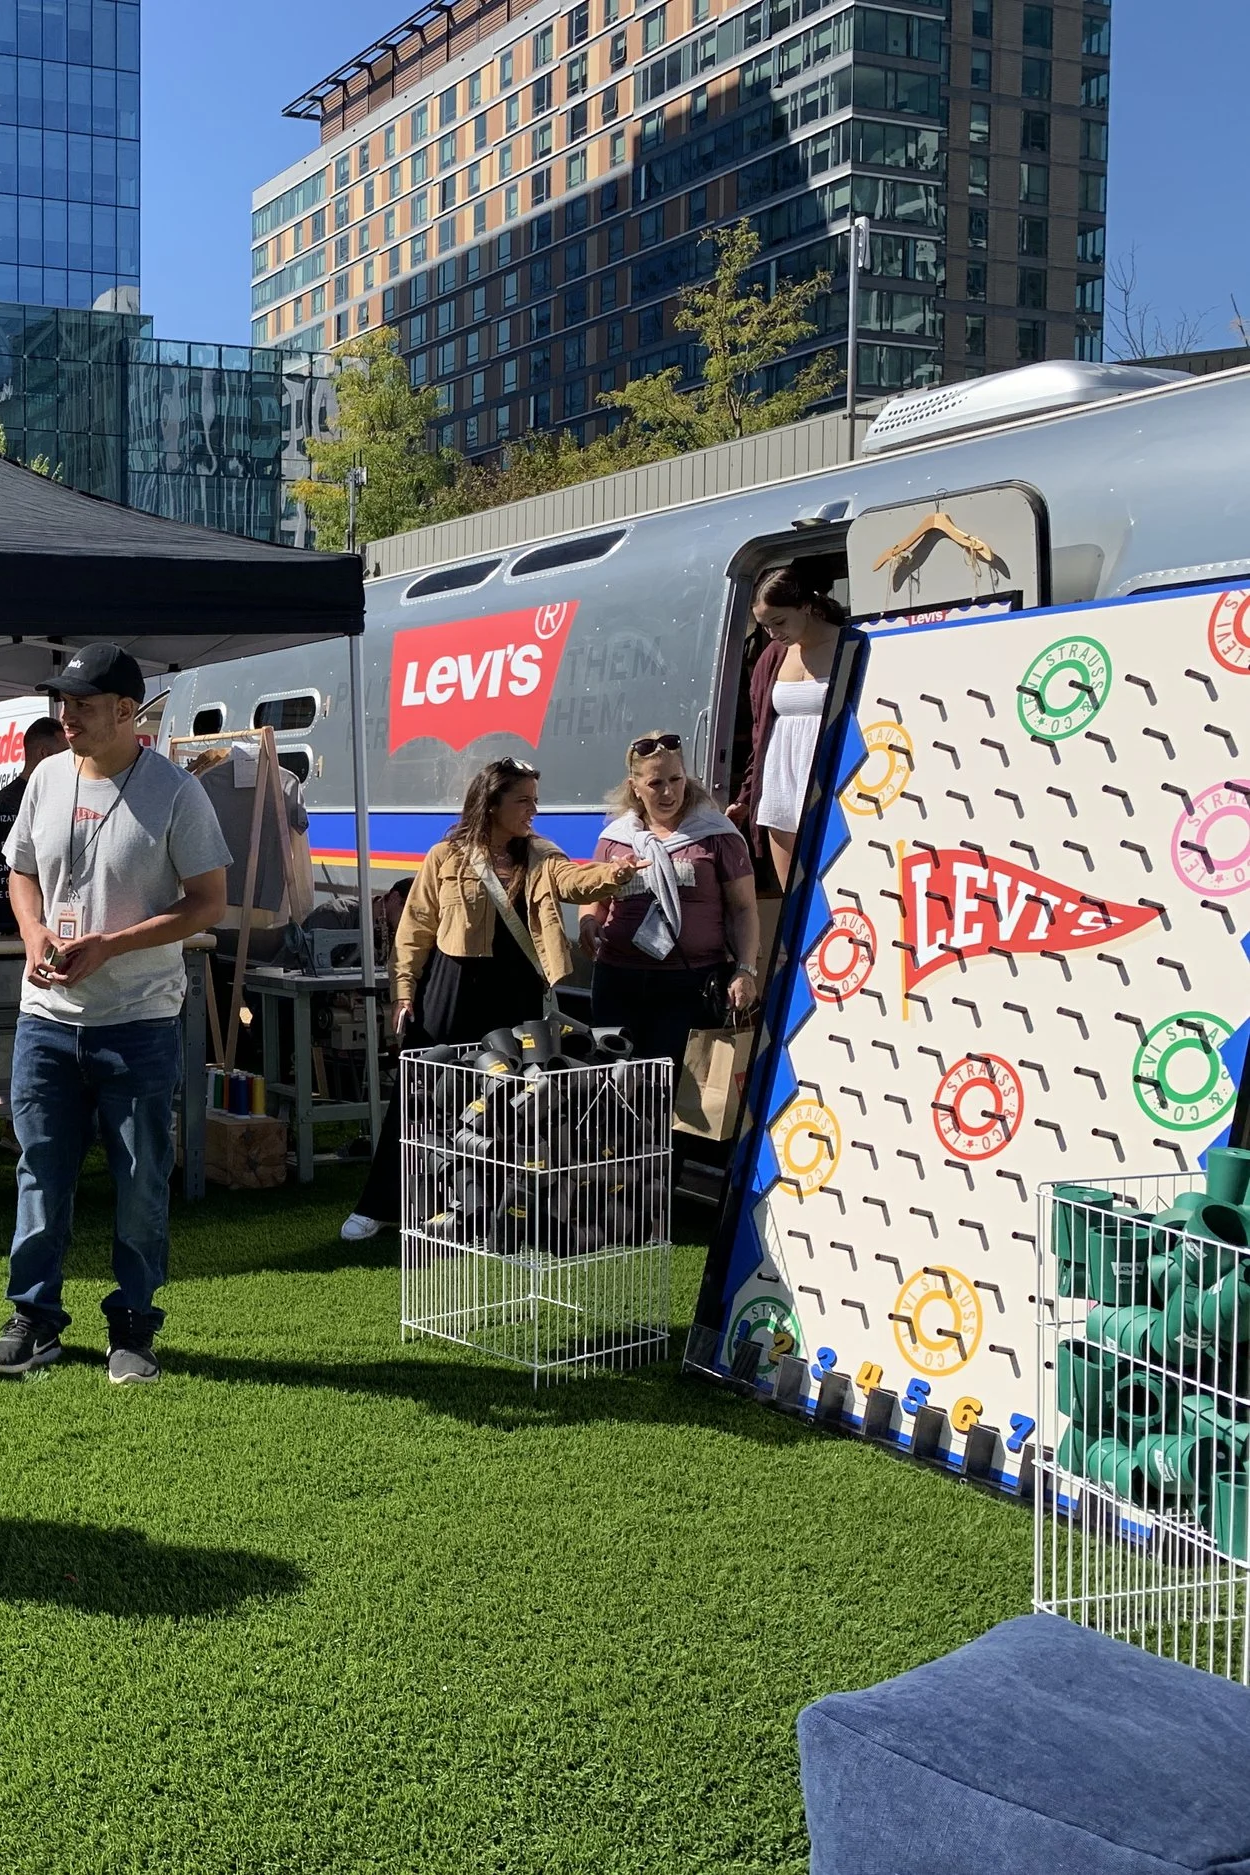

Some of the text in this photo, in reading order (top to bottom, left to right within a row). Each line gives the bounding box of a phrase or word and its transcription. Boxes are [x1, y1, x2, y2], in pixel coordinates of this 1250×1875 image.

[1046, 644, 1105, 690] STRAUSS
[1051, 716, 1073, 734] CO
[911, 860, 1124, 971] LEVI'S
[841, 972, 859, 992] CO
[946, 1063, 1016, 1097] STRAUSS
[981, 1129, 1003, 1151] CO
[1173, 1105, 1200, 1122] CO
[856, 1360, 883, 1396] 4
[901, 1377, 931, 1416] 5
[951, 1396, 983, 1435] 6
[1006, 1412, 1036, 1454] 7
